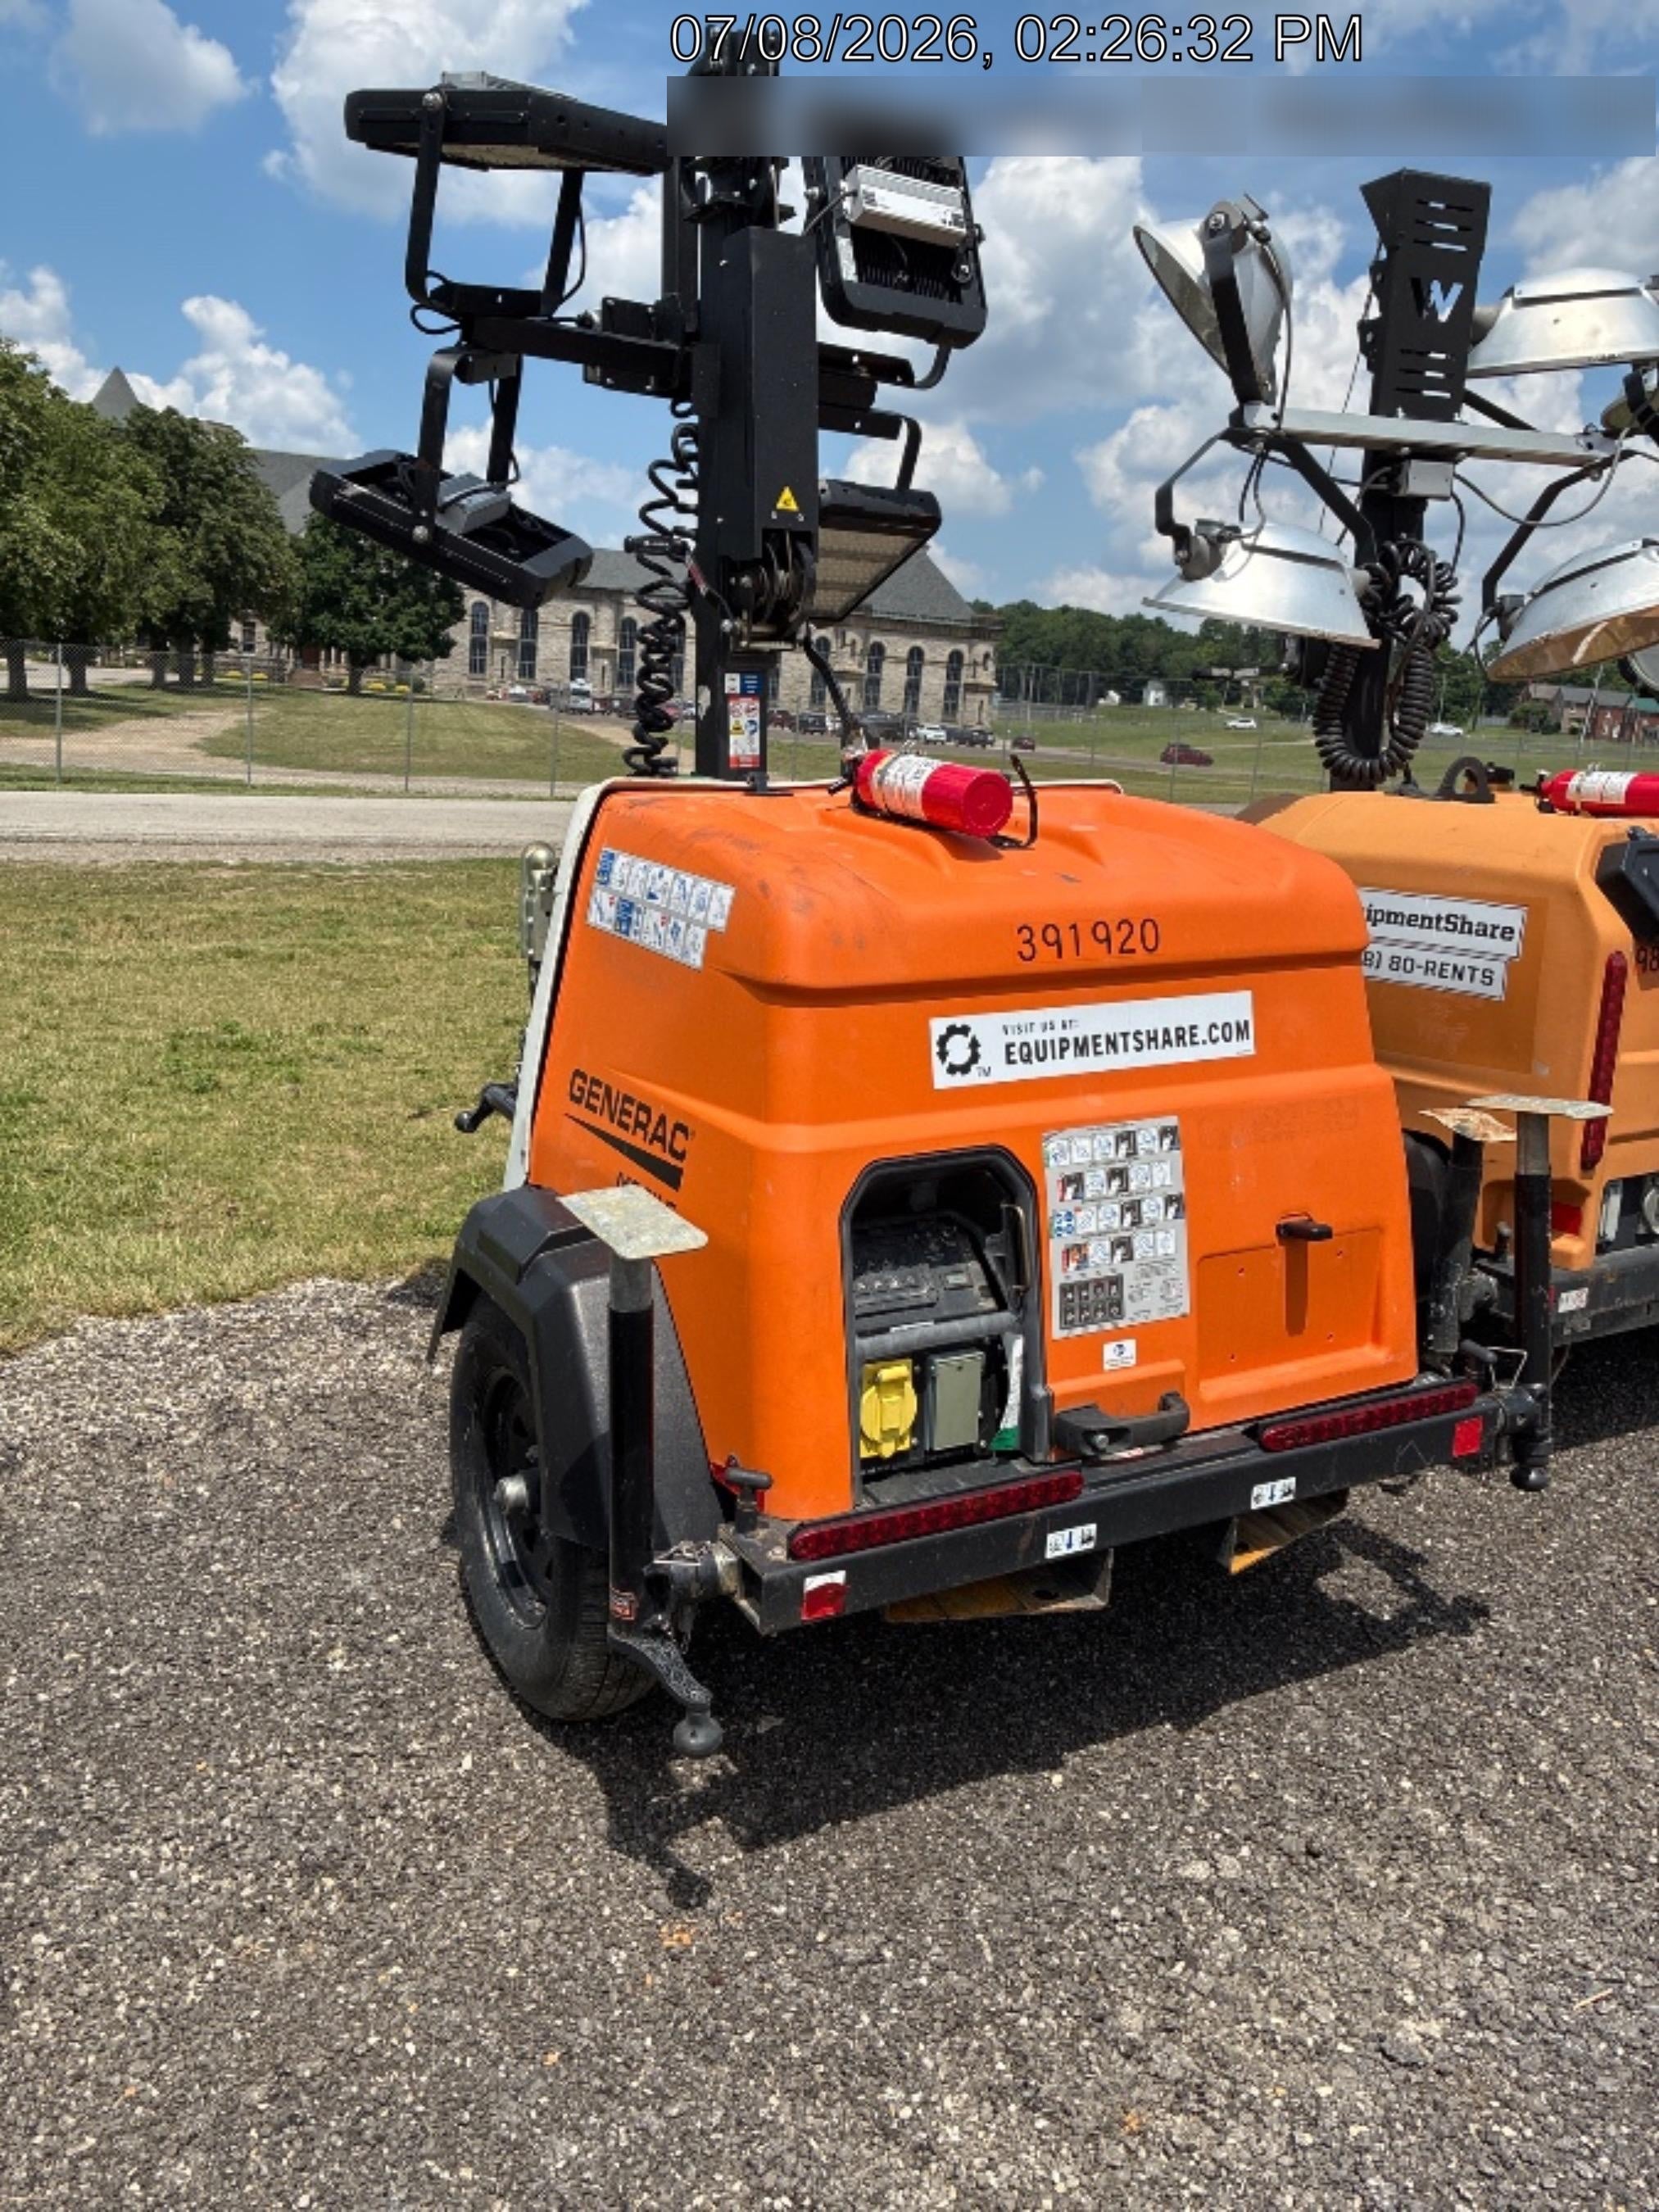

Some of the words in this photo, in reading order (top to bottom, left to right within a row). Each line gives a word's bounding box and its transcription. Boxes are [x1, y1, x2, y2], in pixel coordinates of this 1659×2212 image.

[1016, 918, 1160, 962] 391920
[1362, 904, 1515, 941] ipmentShare
[1388, 954, 1494, 986] 80-RENTS
[1003, 1022, 1035, 1036] VISIT
[1004, 1019, 1250, 1065] EQUIPMENTSHARE.COM
[569, 1068, 689, 1163] GENERAC
